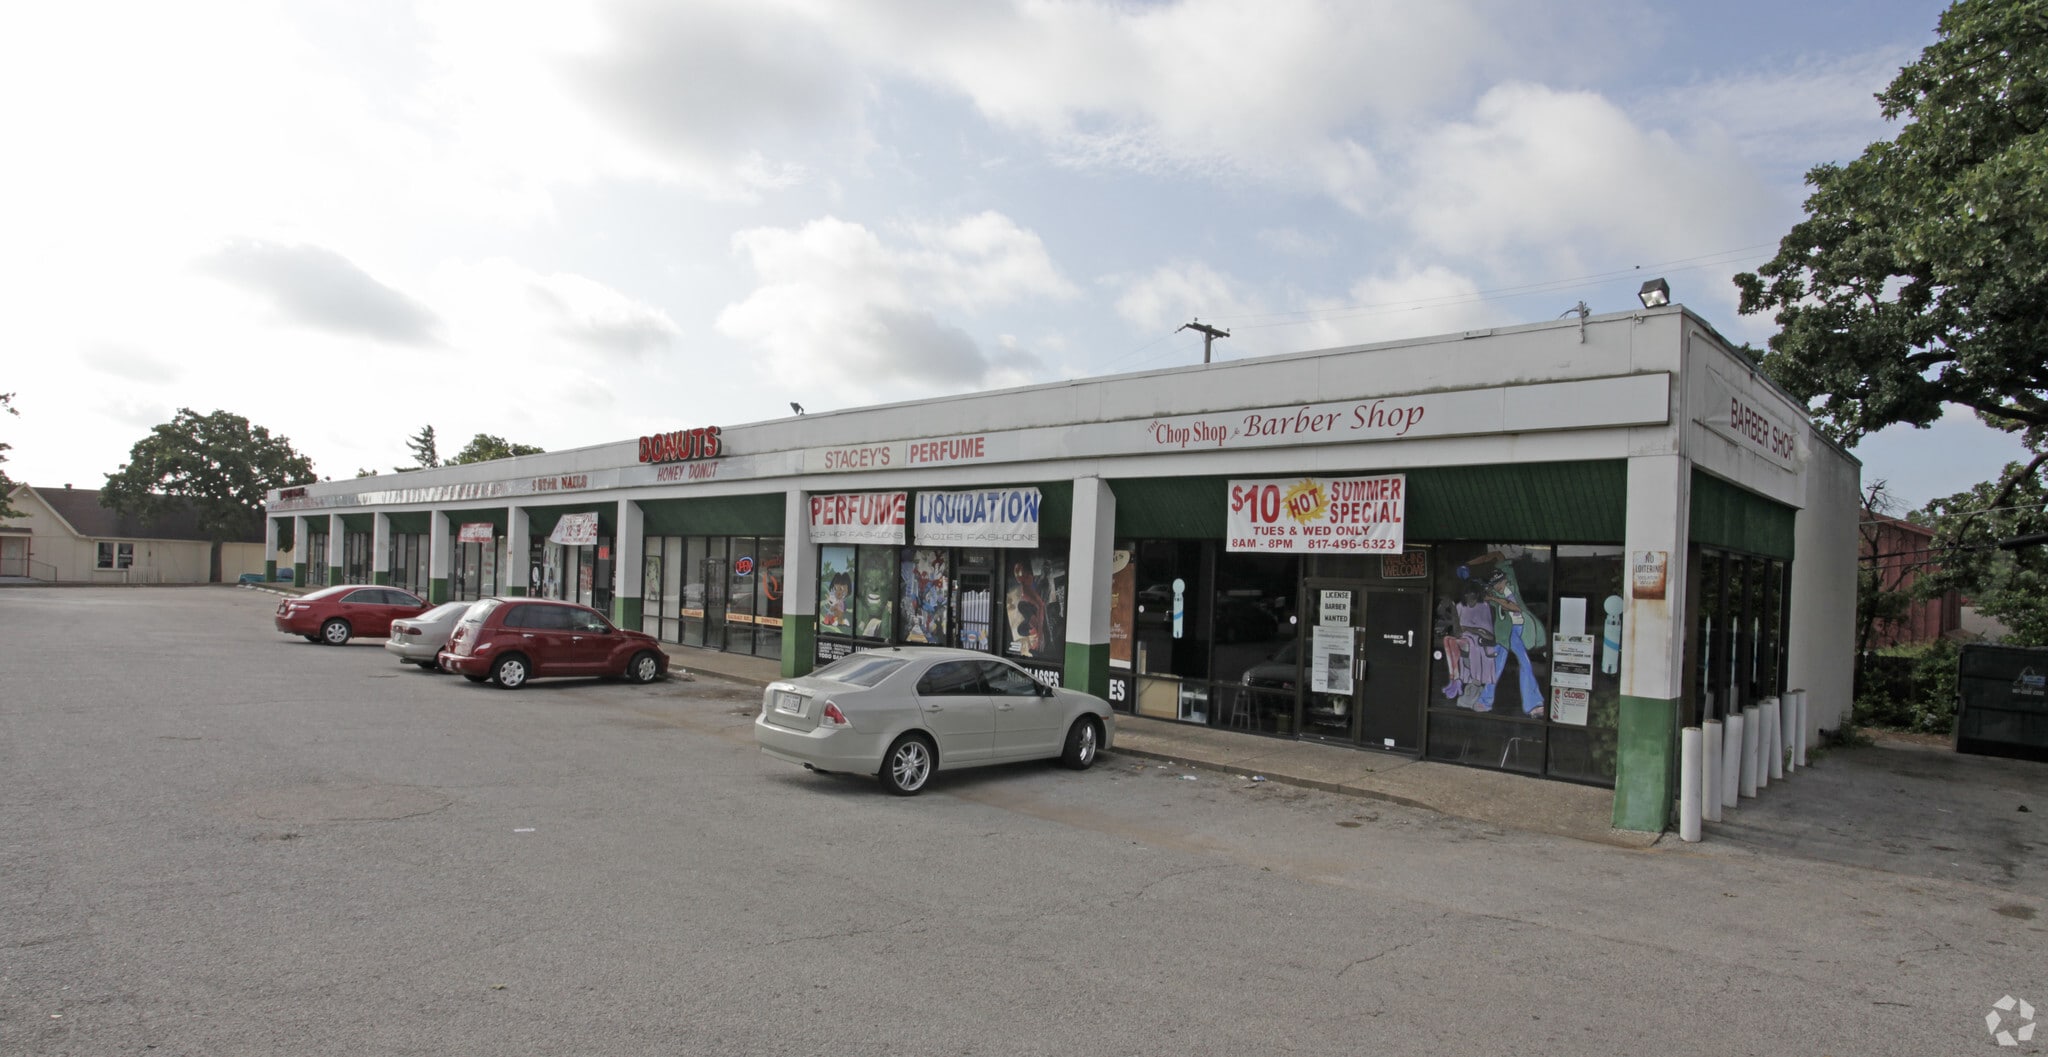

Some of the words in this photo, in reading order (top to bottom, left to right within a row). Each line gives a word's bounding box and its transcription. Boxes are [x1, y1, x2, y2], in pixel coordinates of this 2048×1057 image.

[1156, 424, 1190, 448] Chop
[1193, 421, 1227, 446] Shop
[1244, 406, 1341, 437] Barber
[1350, 400, 1424, 436] Shop
[1731, 397, 1769, 449] BARBER
[1772, 426, 1794, 461] SHOP
[639, 426, 722, 463] DONUTS
[825, 447, 890, 469] STACEY'S
[910, 437, 985, 463] PERFUME
[657, 466, 684, 482] HONEY
[689, 462, 718, 479] DONUT
[1331, 479, 1401, 501] SUMMER
[811, 493, 905, 526] PERFUME
[919, 489, 1038, 525] LIQUIDATION
[1231, 484, 1281, 524] $10
[1288, 488, 1320, 519] HOT
[1330, 502, 1401, 524] SPECIAL
[848, 531, 904, 539] FASHIONS
[967, 533, 1037, 542] FASHIONS
[1232, 538, 1257, 548] 8AM
[1268, 539, 1293, 549] 8PM
[1308, 539, 1396, 550] 817-496-6323
[1254, 526, 1285, 536] TUES
[1289, 526, 1297, 536] &
[1303, 526, 1331, 536] WED
[1336, 526, 1371, 536] ONLY
[1384, 564, 1425, 577] WELCOME
